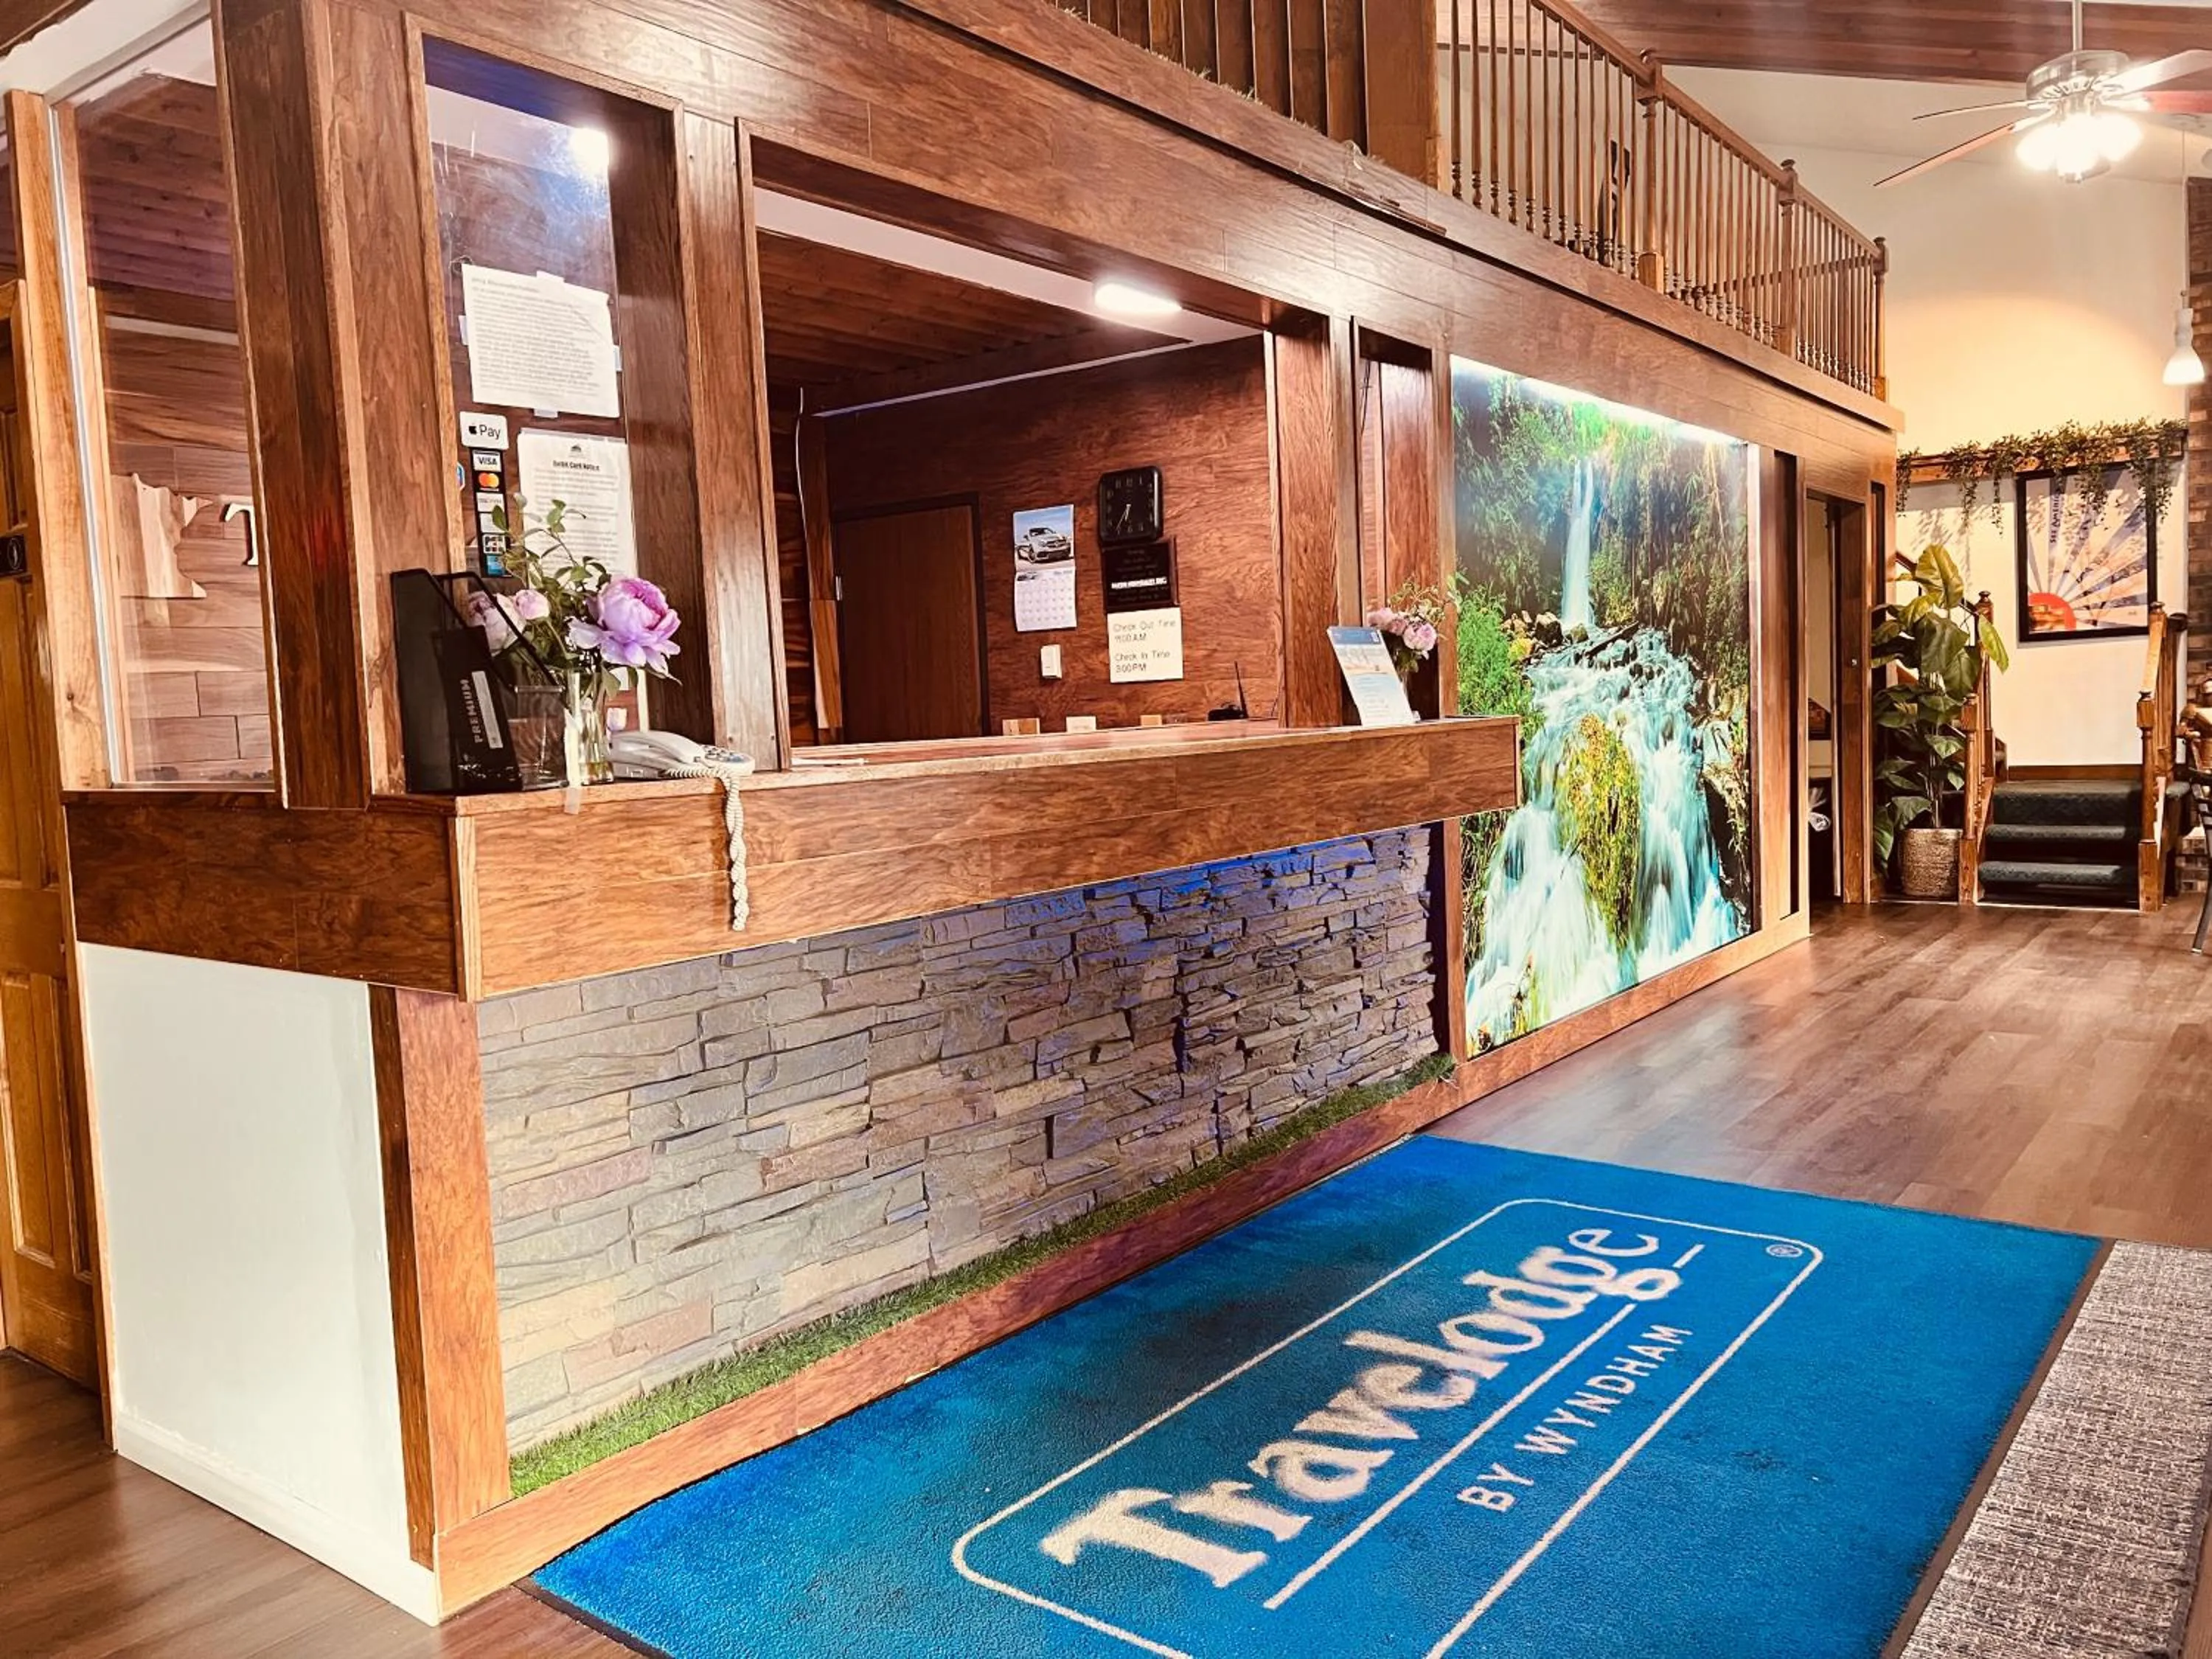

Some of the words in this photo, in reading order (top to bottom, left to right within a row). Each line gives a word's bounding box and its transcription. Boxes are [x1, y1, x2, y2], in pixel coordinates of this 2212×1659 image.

[479, 425, 501, 439] Pay
[479, 457, 498, 465] VISA
[1114, 653, 1137, 661] Check
[1141, 651, 1148, 659] In
[1152, 650, 1170, 658] Time
[460, 679, 483, 743] PREMIUM
[1040, 1228, 1682, 1588] Travelodge
[1456, 1462, 1534, 1512] BY
[1514, 1324, 1694, 1455] WYNDHAM
